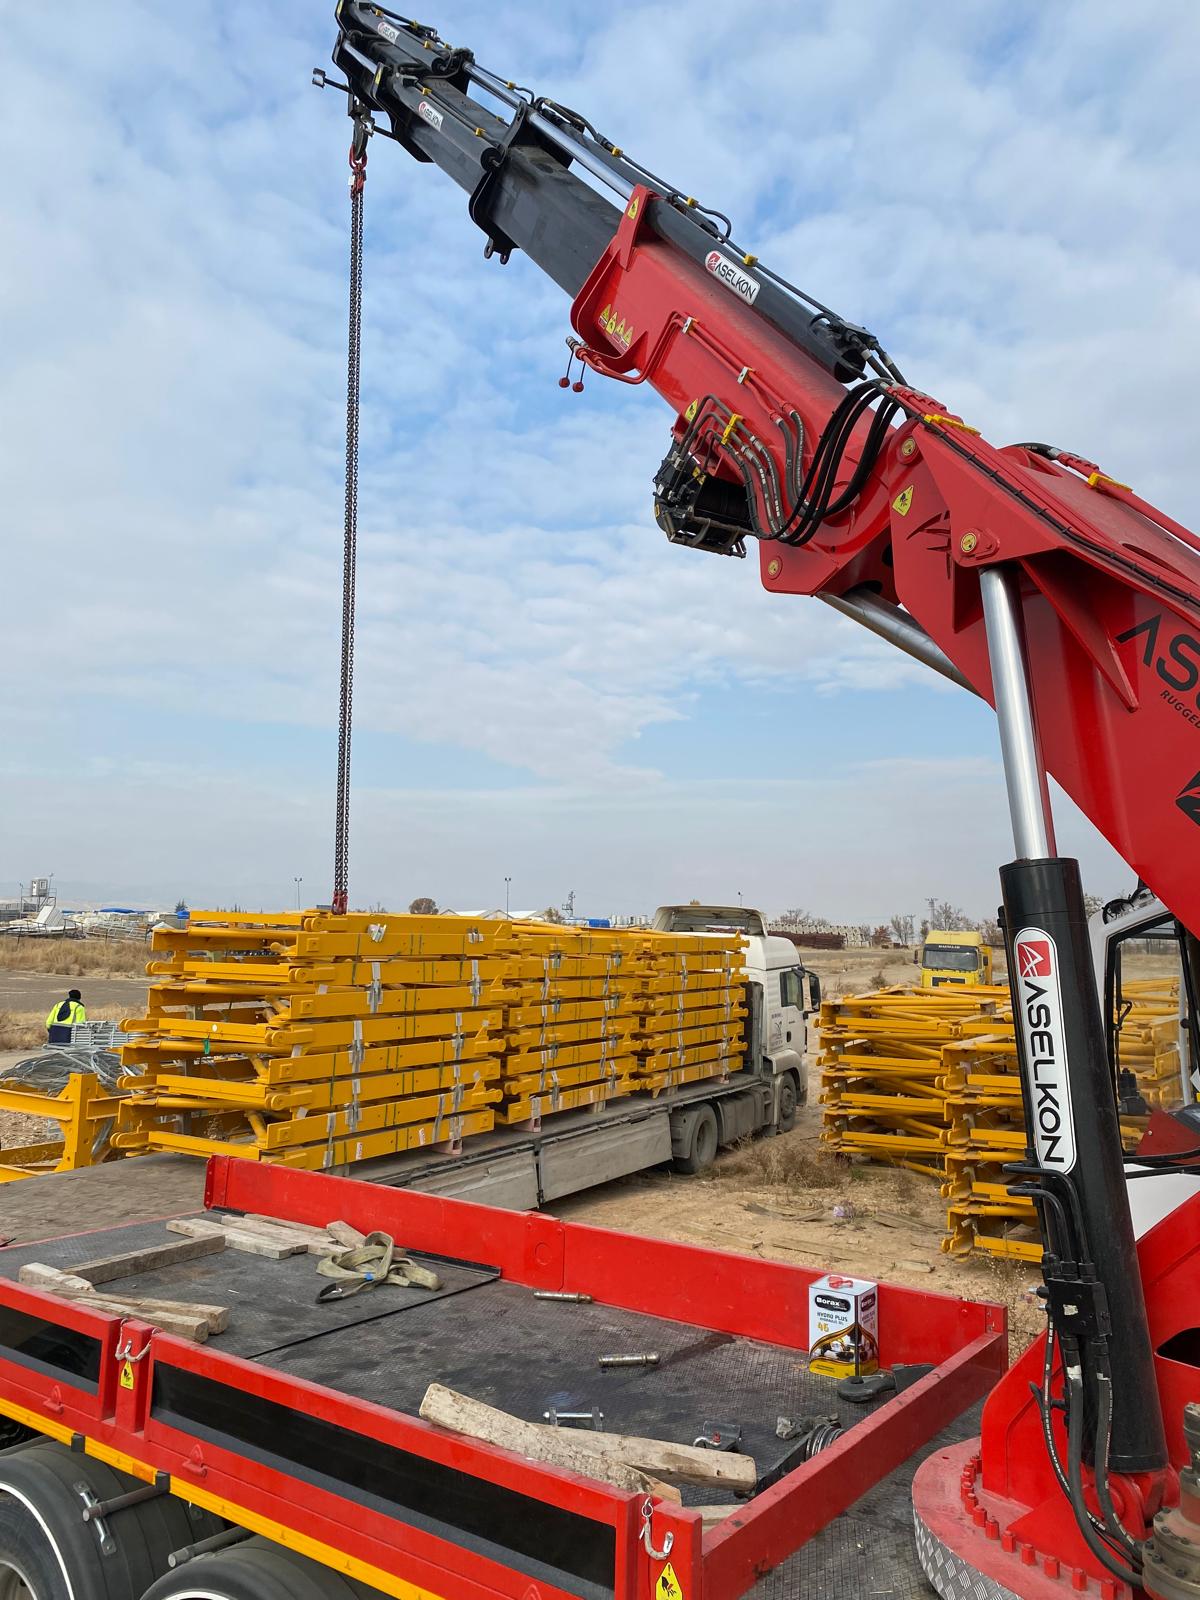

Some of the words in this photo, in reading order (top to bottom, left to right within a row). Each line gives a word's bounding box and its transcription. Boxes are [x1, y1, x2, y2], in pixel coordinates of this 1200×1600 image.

[714, 262, 756, 299] ASELKON
[1114, 614, 1200, 711] AS
[1024, 980, 1065, 1163] ASELKON
[816, 1297, 840, 1307] Borax
